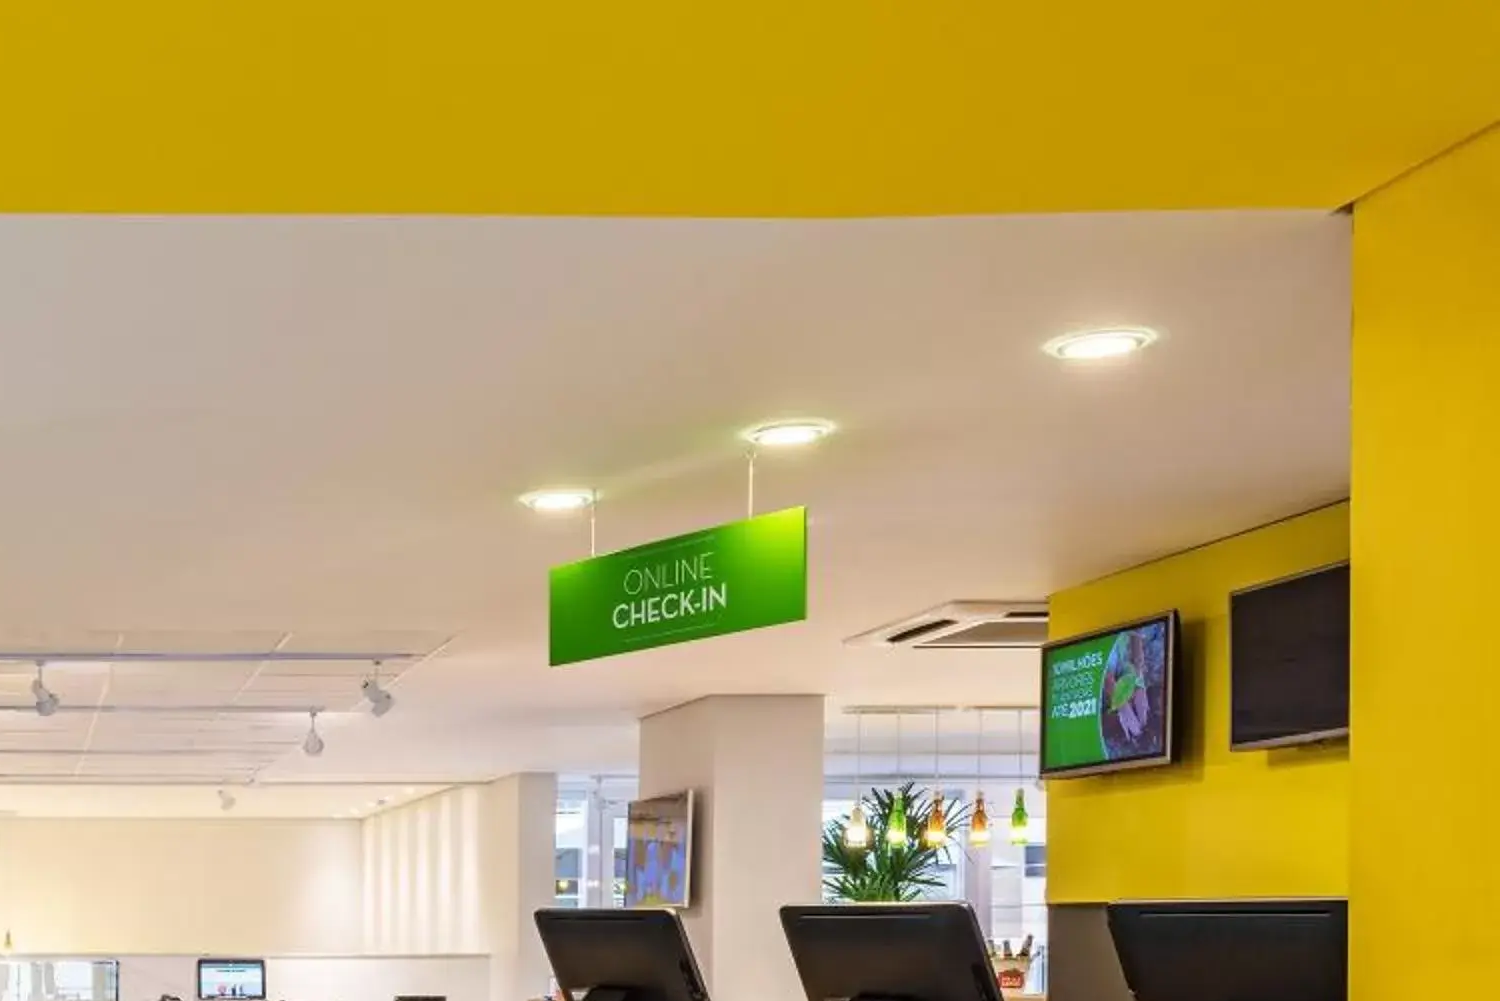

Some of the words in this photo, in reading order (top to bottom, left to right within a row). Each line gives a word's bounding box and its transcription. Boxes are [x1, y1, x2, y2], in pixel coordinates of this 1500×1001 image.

[623, 552, 714, 596] ONLINE
[612, 583, 727, 629] CHECK-IN
[1069, 697, 1097, 718] 2021
